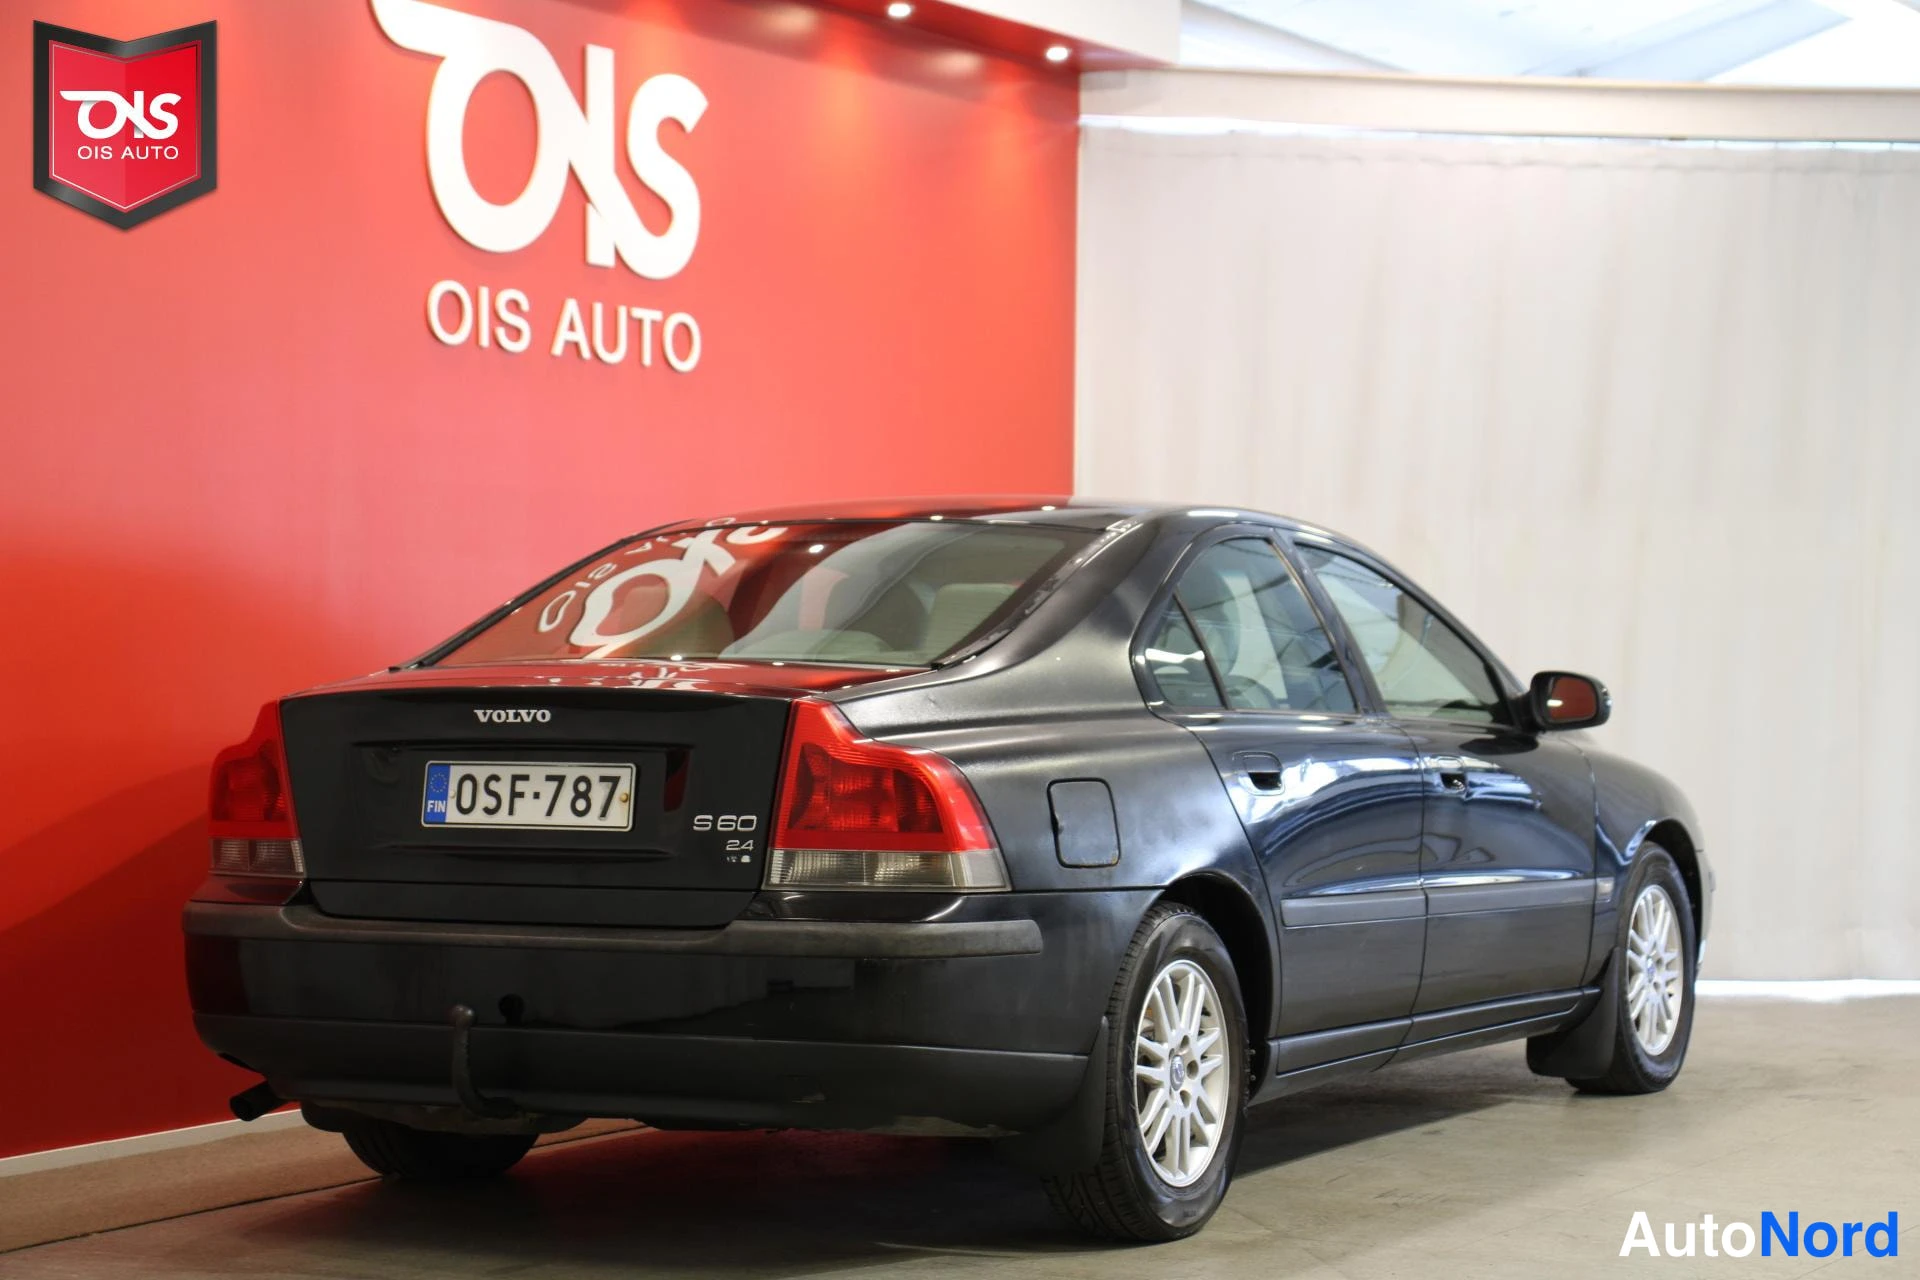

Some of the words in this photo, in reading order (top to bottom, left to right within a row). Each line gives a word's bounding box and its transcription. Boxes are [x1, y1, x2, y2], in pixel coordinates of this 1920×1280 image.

[372, 0, 709, 280] OIS
[428, 279, 531, 354] OIS
[551, 298, 702, 373] AUTO
[473, 709, 552, 723] VOLVO
[427, 799, 447, 814] FIN
[455, 773, 622, 819] OSF-787
